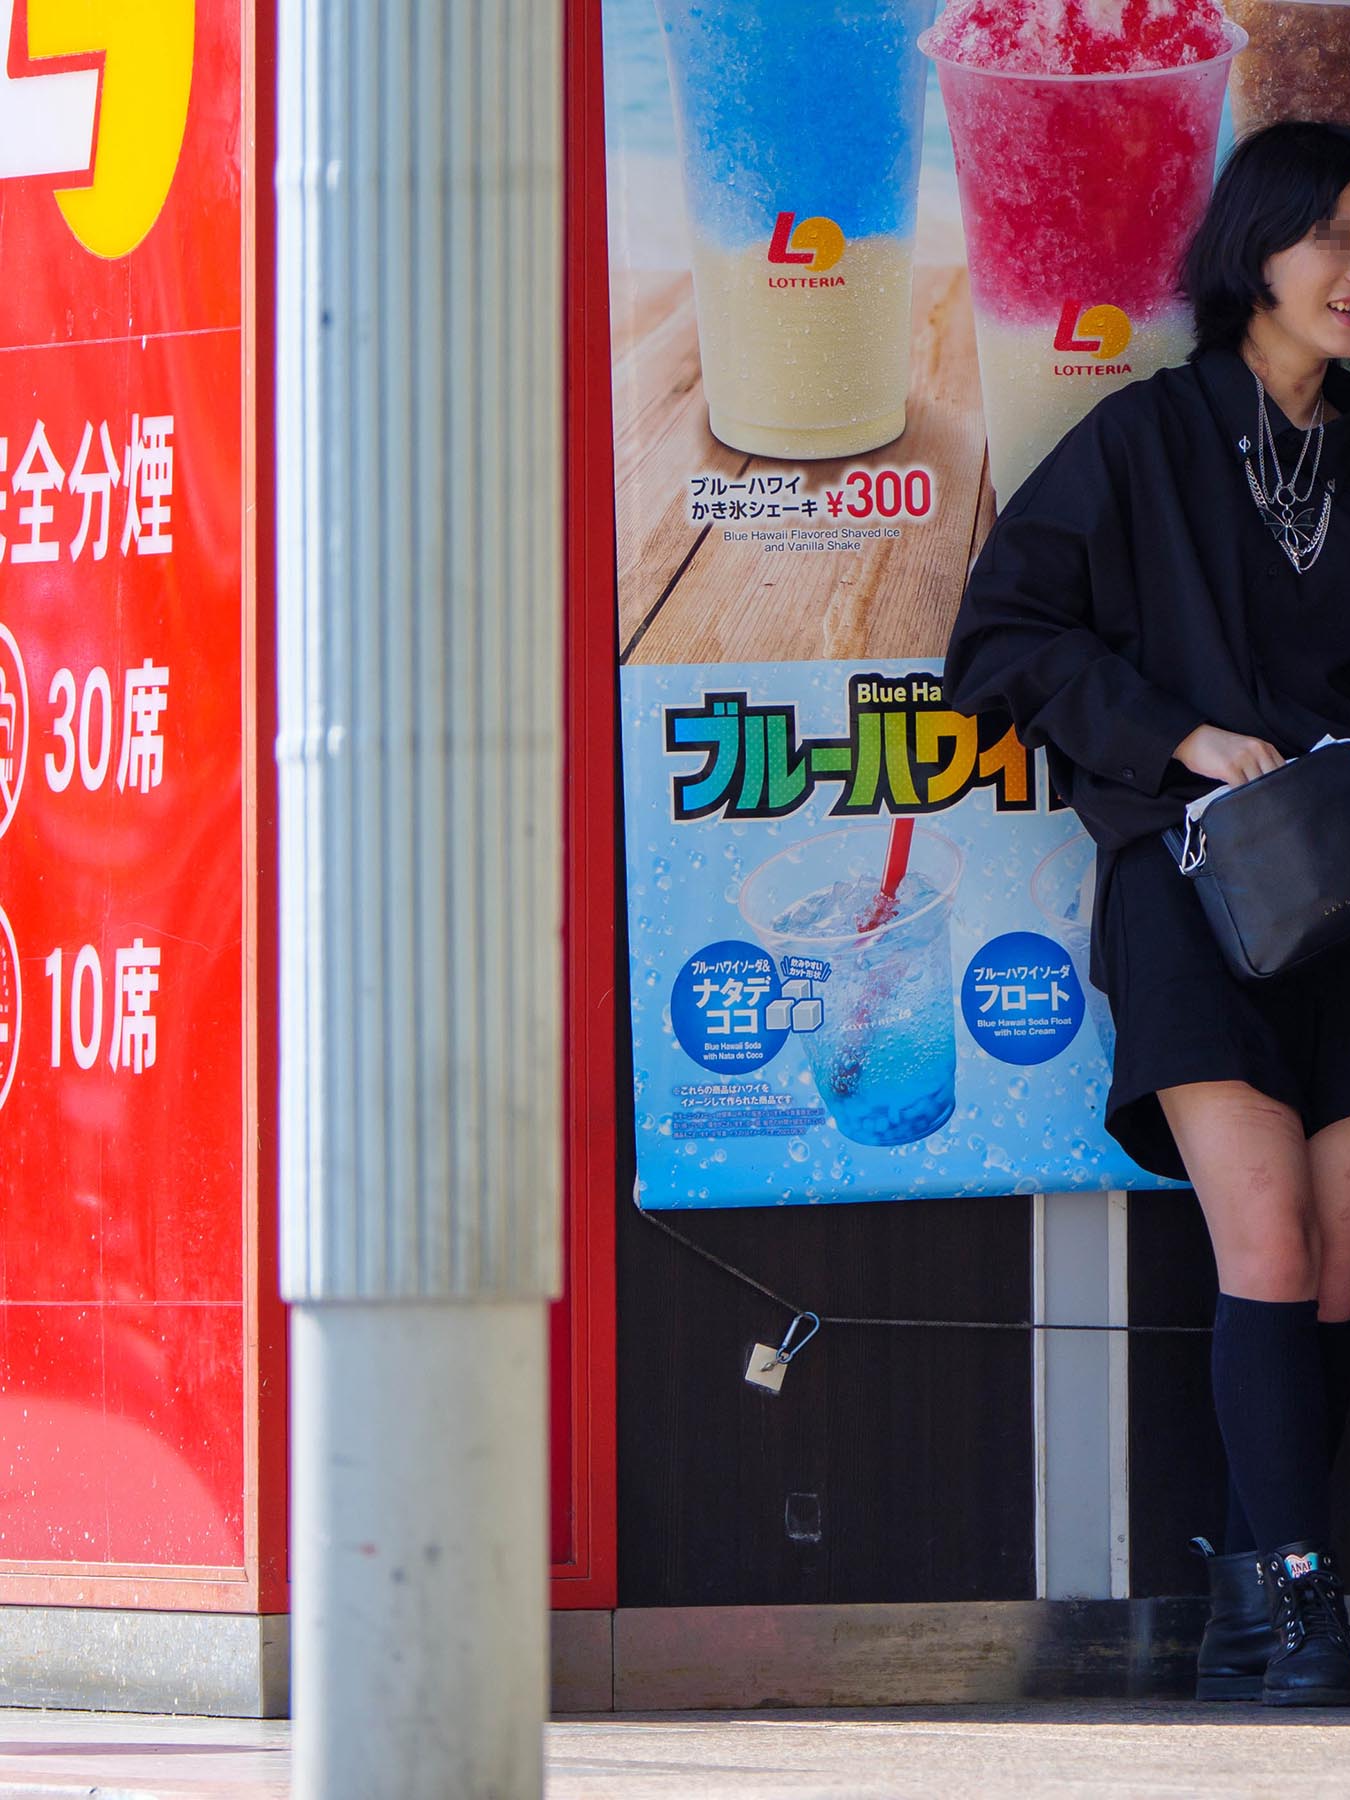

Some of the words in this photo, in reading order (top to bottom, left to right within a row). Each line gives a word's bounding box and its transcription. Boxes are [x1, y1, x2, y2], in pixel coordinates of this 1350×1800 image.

[768, 276, 846, 289] LOTTERIA
[1053, 363, 1132, 377] LOTTERIA
[0, 413, 174, 564] 全分煙
[690, 476, 801, 497] ブルーハワイ
[825, 469, 932, 518] ¥300
[691, 499, 819, 520] かき氷シェーキ
[723, 531, 748, 541] Blue
[751, 530, 788, 541] Hawaii
[791, 529, 838, 540] Flavored
[841, 528, 881, 539] Shaved
[884, 528, 900, 537] Ice
[764, 542, 785, 552] and
[787, 541, 825, 551] Vanilla
[827, 541, 861, 550] Shake
[857, 683, 907, 704] Blue
[45, 657, 170, 795] 30席
[674, 701, 1028, 812] ブルーハワイ
[973, 964, 1071, 982] ブルーハワイソーダ
[693, 976, 772, 1008] ナタデ
[974, 981, 1070, 1013] フロート
[45, 937, 161, 1075] 10席
[706, 1009, 758, 1034] ココ
[977, 1019, 996, 1027] Blue
[998, 1019, 1026, 1027] Hawaii
[1028, 1018, 1049, 1026] Soda
[1051, 1017, 1072, 1025] Float
[994, 1029, 1012, 1037] with
[1028, 1028, 1056, 1036] Cream
[744, 1041, 761, 1050] Soda
